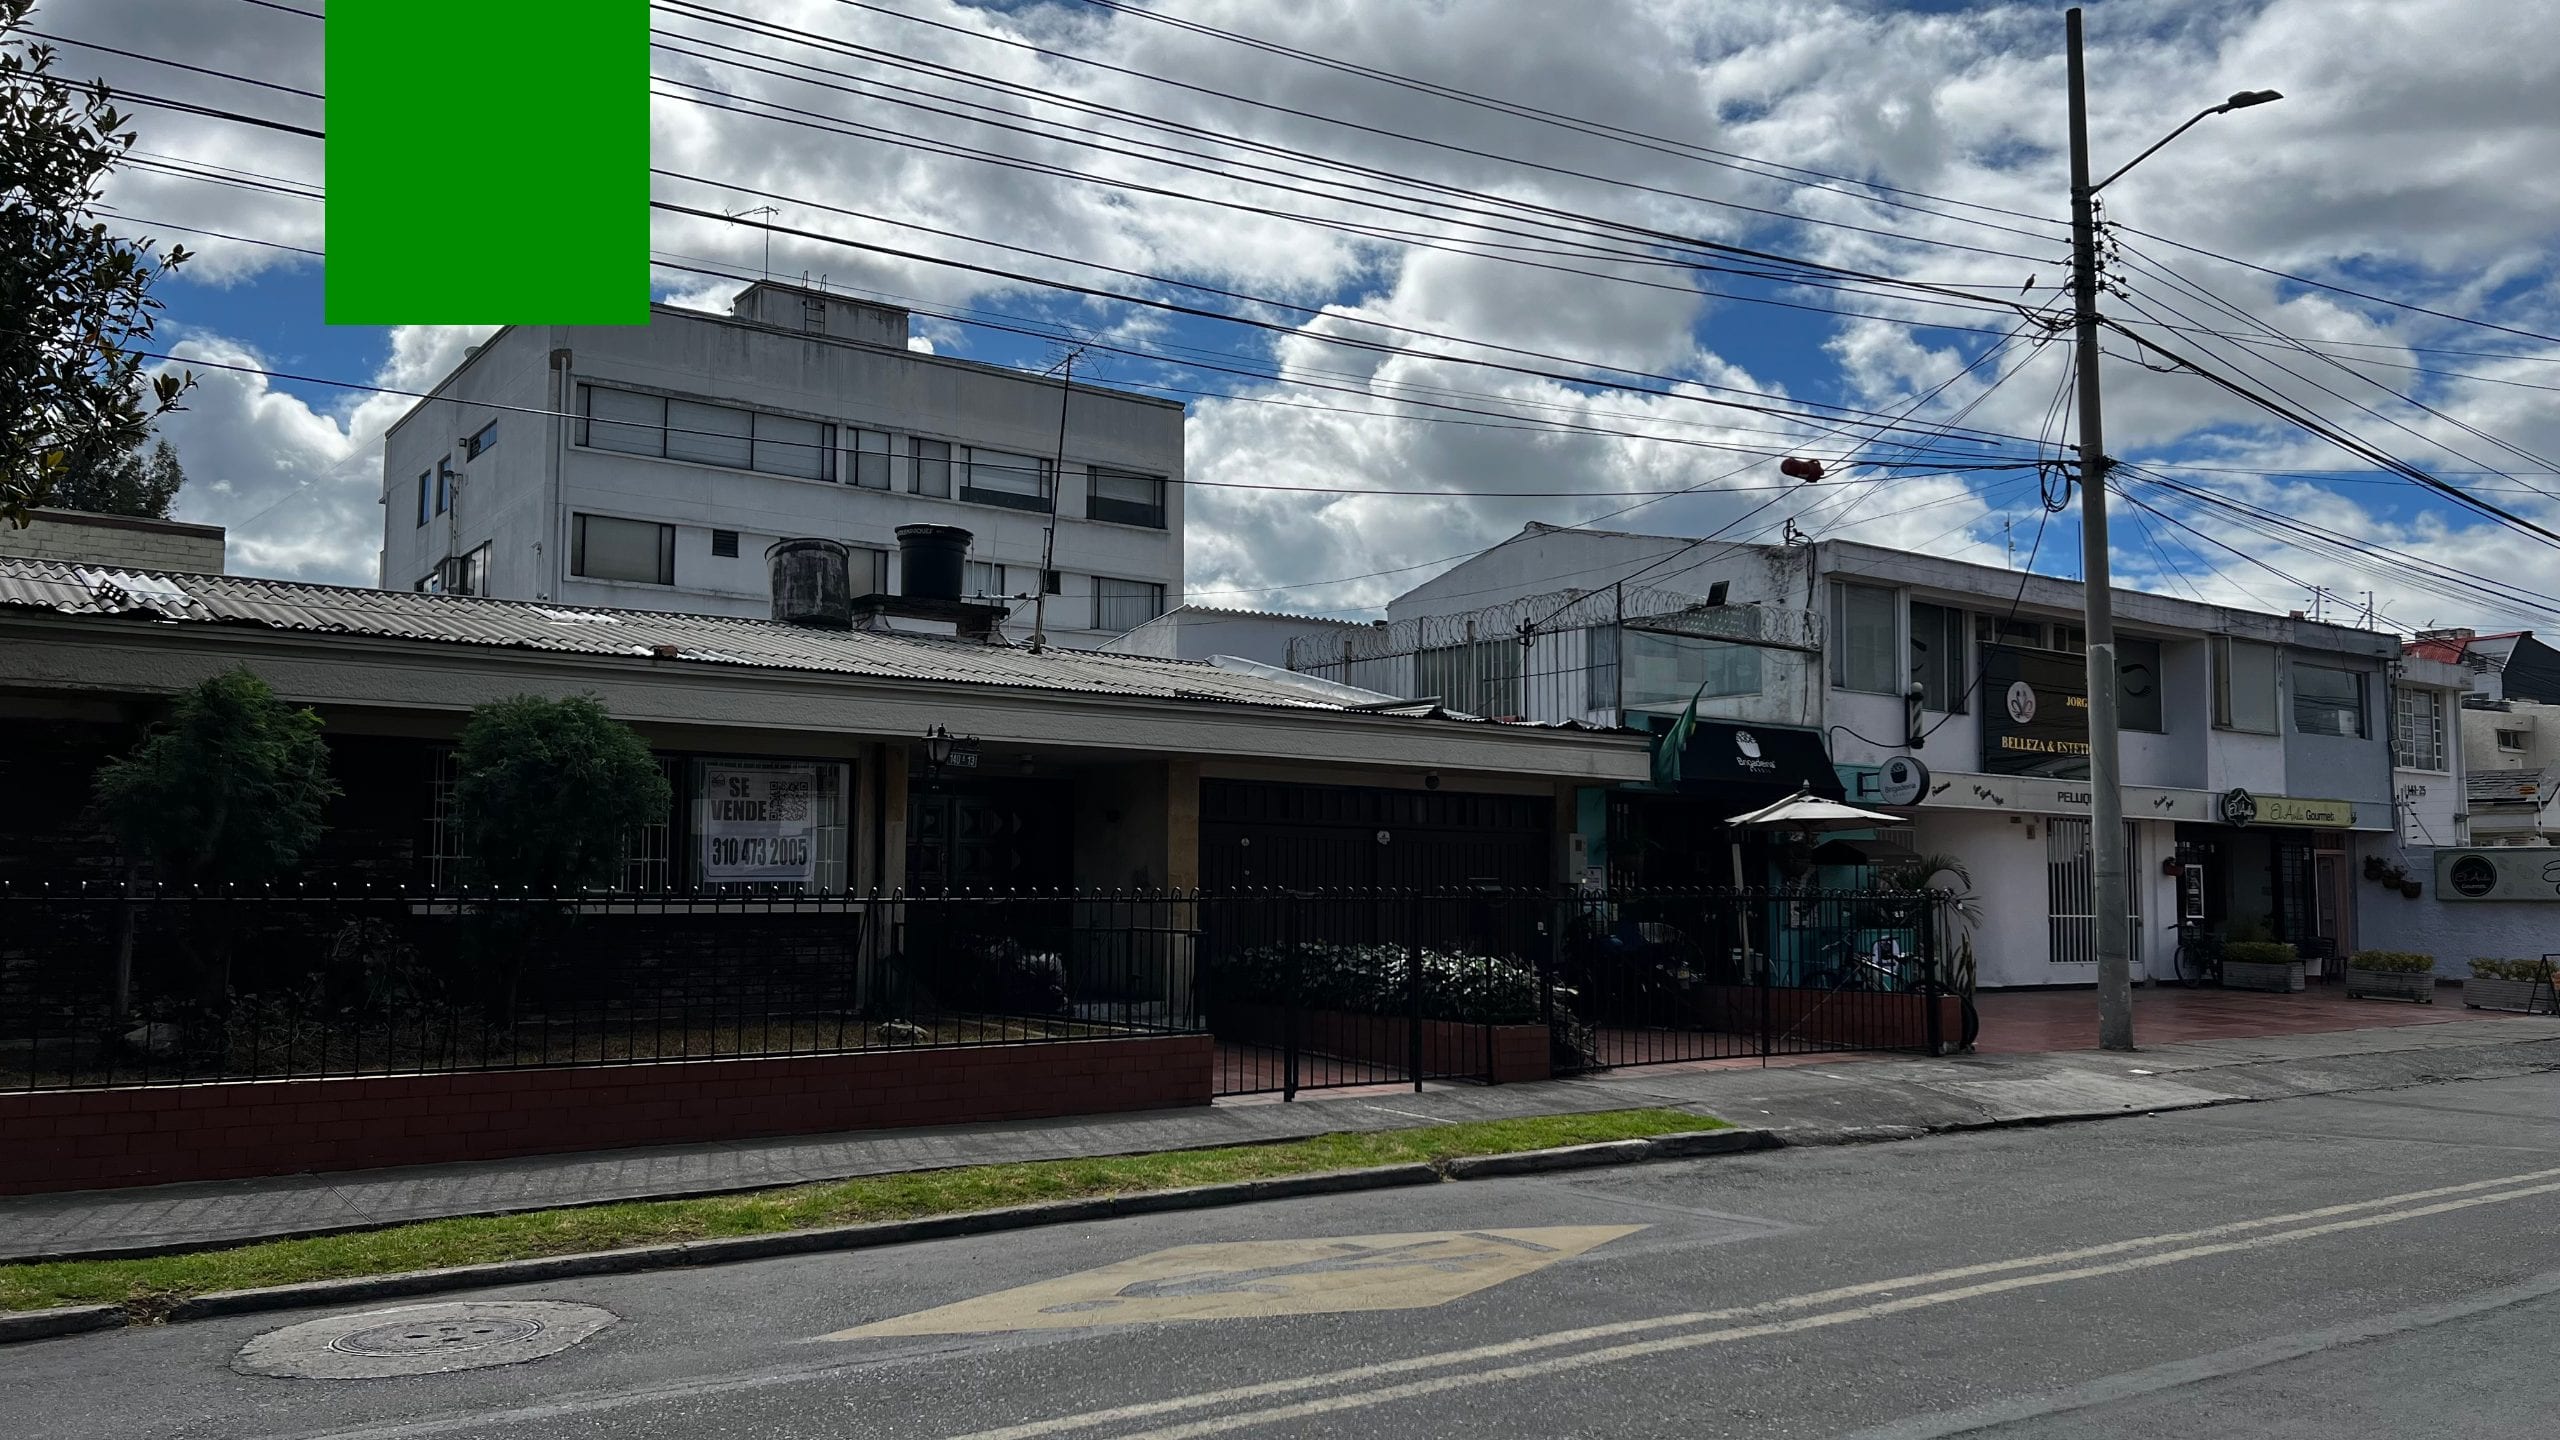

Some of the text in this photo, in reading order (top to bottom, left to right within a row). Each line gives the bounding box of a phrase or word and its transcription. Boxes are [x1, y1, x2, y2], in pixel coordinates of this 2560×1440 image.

[2066, 696, 2088, 707] JORG
[2001, 735, 2090, 755] BELLEZA & ESTETI
[728, 777, 750, 797] SE
[2057, 791, 2092, 806] PELUQ
[711, 799, 767, 821] VENDE
[2305, 810, 2335, 822] Gourmet
[712, 838, 808, 866] 310 473 2005
